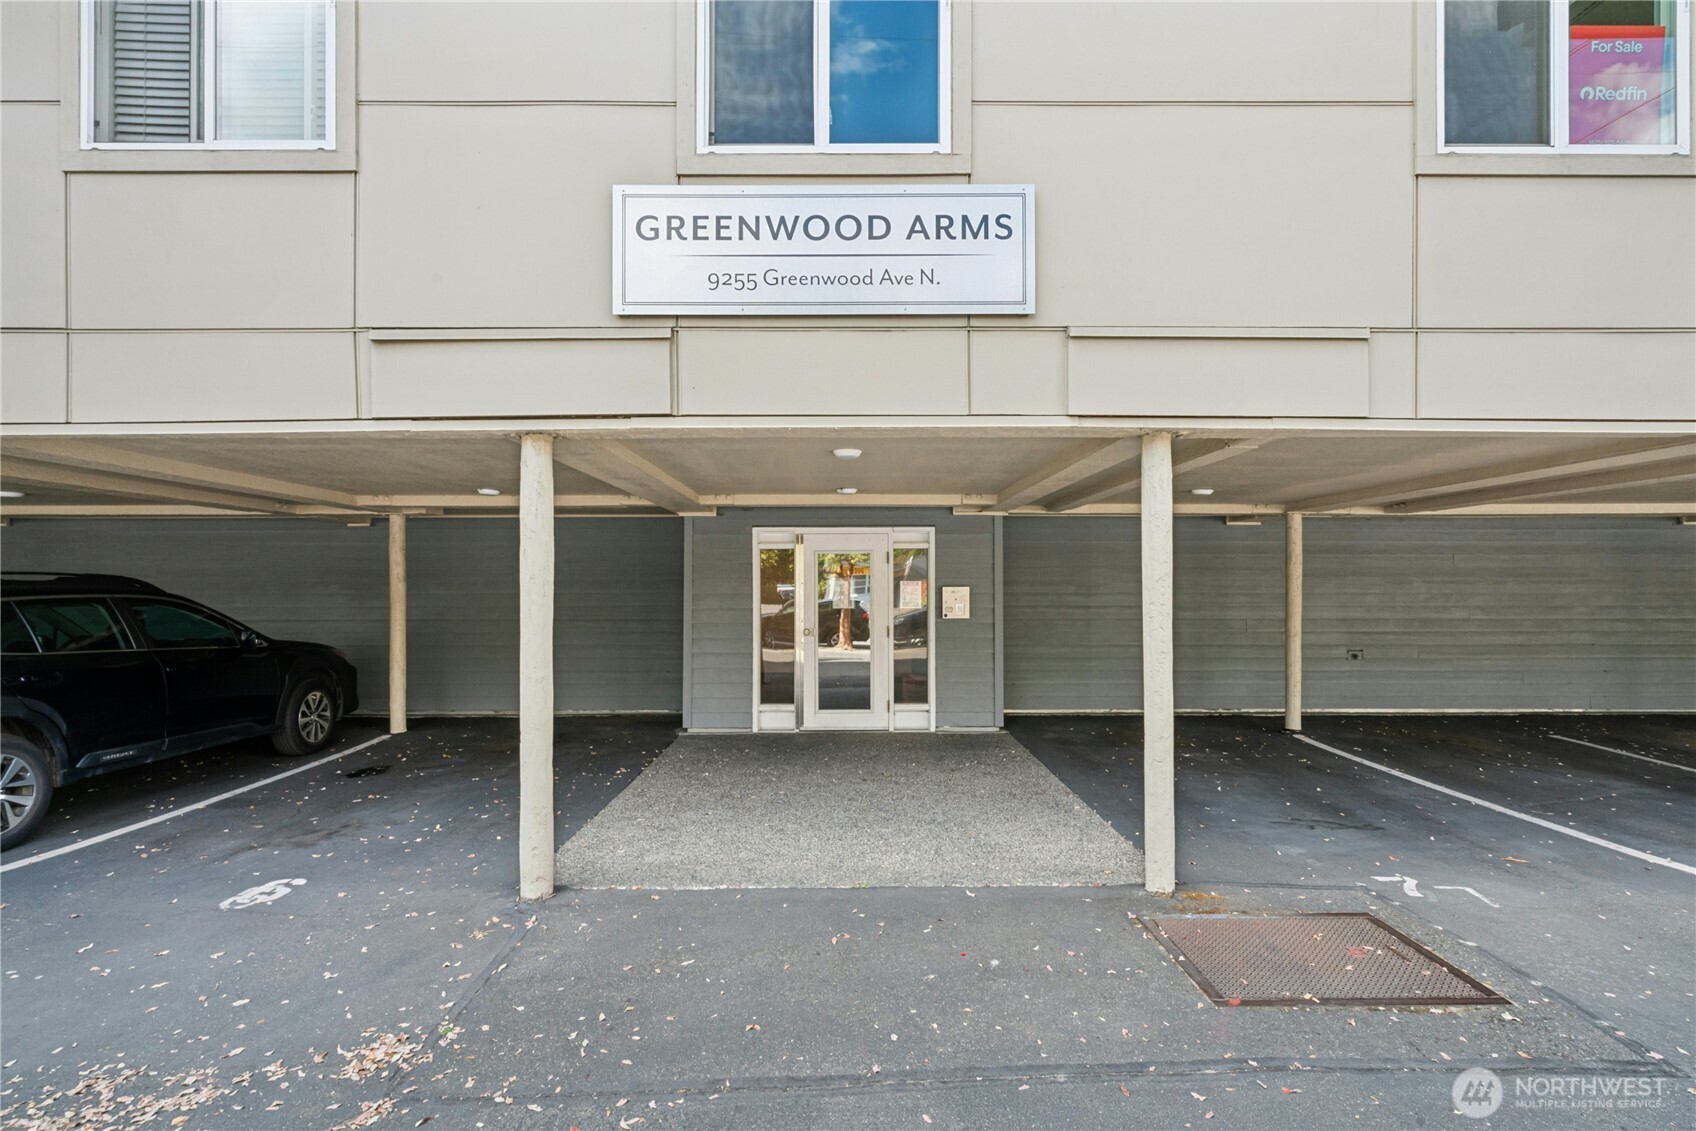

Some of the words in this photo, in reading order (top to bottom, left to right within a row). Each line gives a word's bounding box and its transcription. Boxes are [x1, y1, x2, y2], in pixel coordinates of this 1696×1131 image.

[1591, 40, 1612, 53] For
[1615, 40, 1643, 53] Sale
[1595, 86, 1647, 101] Redfin
[635, 214, 892, 241] GREENWOOD
[906, 213, 1013, 241] ARMS
[707, 271, 757, 291] 9255
[763, 268, 873, 286] Greenwood
[879, 268, 914, 286] Ave
[920, 268, 941, 286] N.
